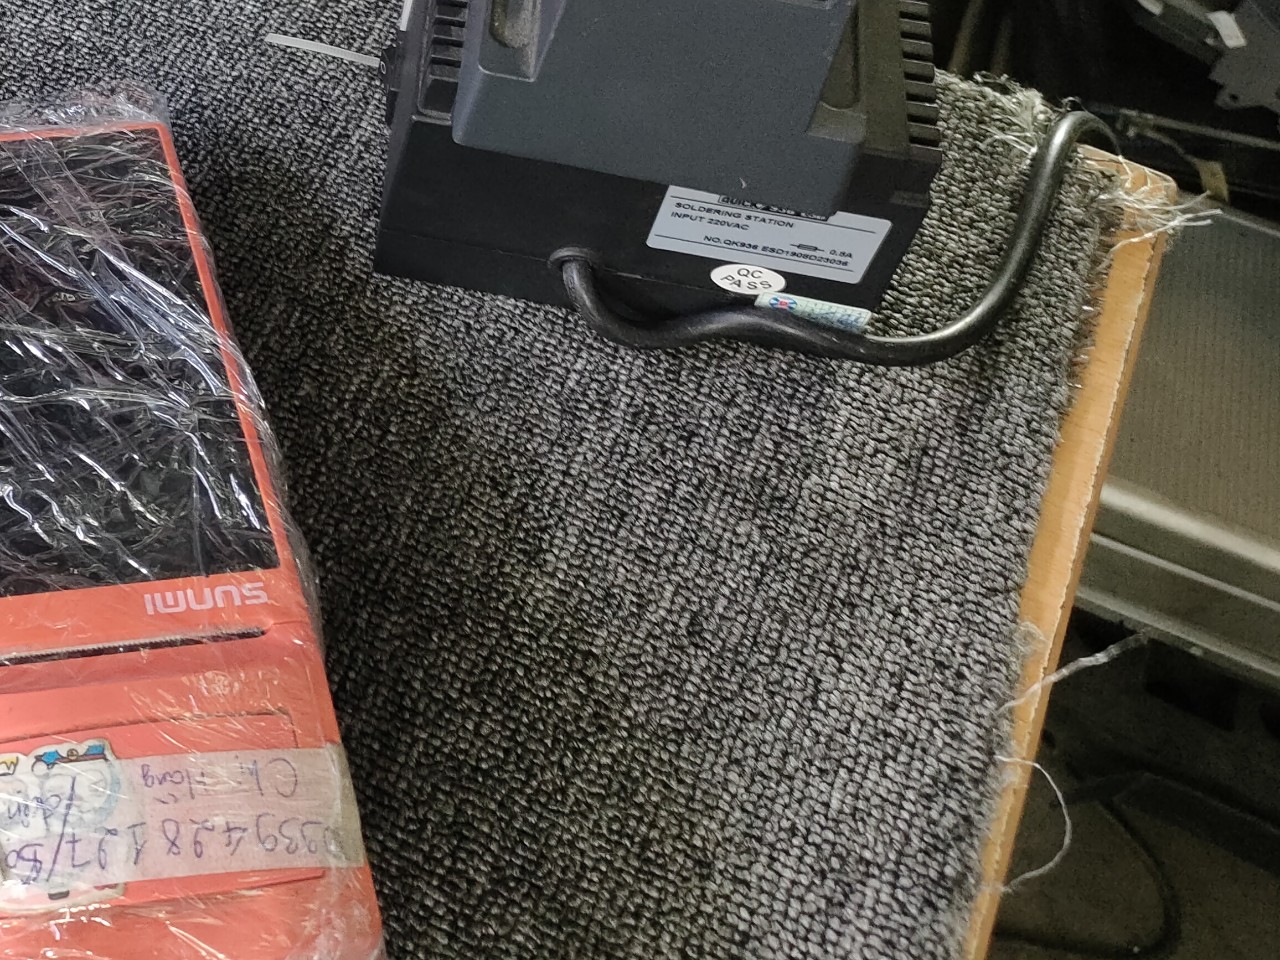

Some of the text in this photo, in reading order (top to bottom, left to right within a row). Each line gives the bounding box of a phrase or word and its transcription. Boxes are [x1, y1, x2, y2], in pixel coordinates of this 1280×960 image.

[671, 212, 750, 232] INPUT 220VAC
[674, 202, 742, 220] SOLDERING
[744, 214, 795, 229] STATION
[720, 274, 773, 291] PASS
[736, 268, 765, 280] QC
